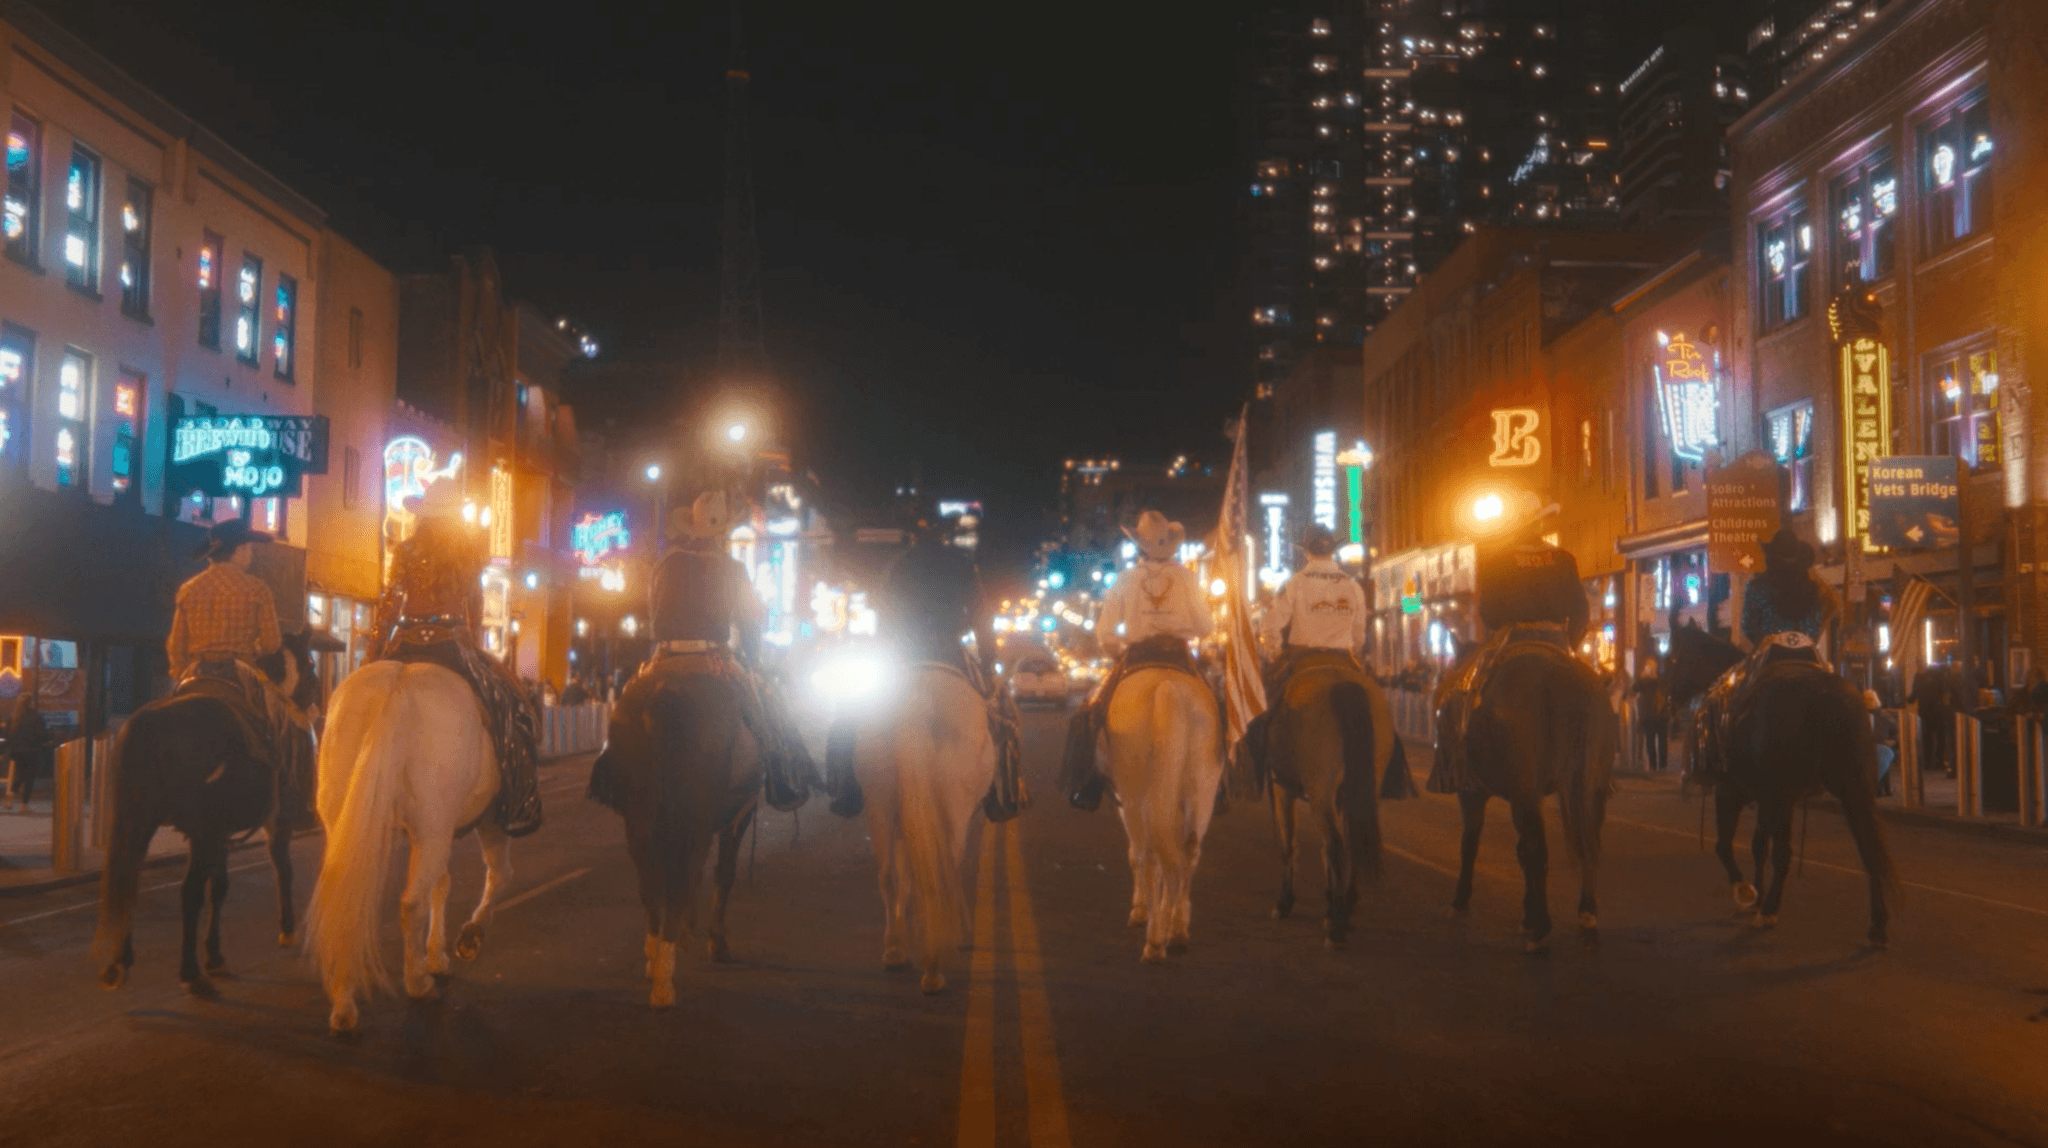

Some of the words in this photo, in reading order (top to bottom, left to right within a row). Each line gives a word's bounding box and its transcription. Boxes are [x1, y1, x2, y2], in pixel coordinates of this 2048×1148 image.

[1872, 467, 1923, 479] Korean
[1711, 484, 1745, 494] SoBro
[1873, 483, 1905, 496] Vets
[1909, 482, 1957, 499] Bridge
[1712, 496, 1777, 508] Attractions
[1712, 518, 1768, 529] Childrens
[1714, 531, 1758, 542] Theatre
